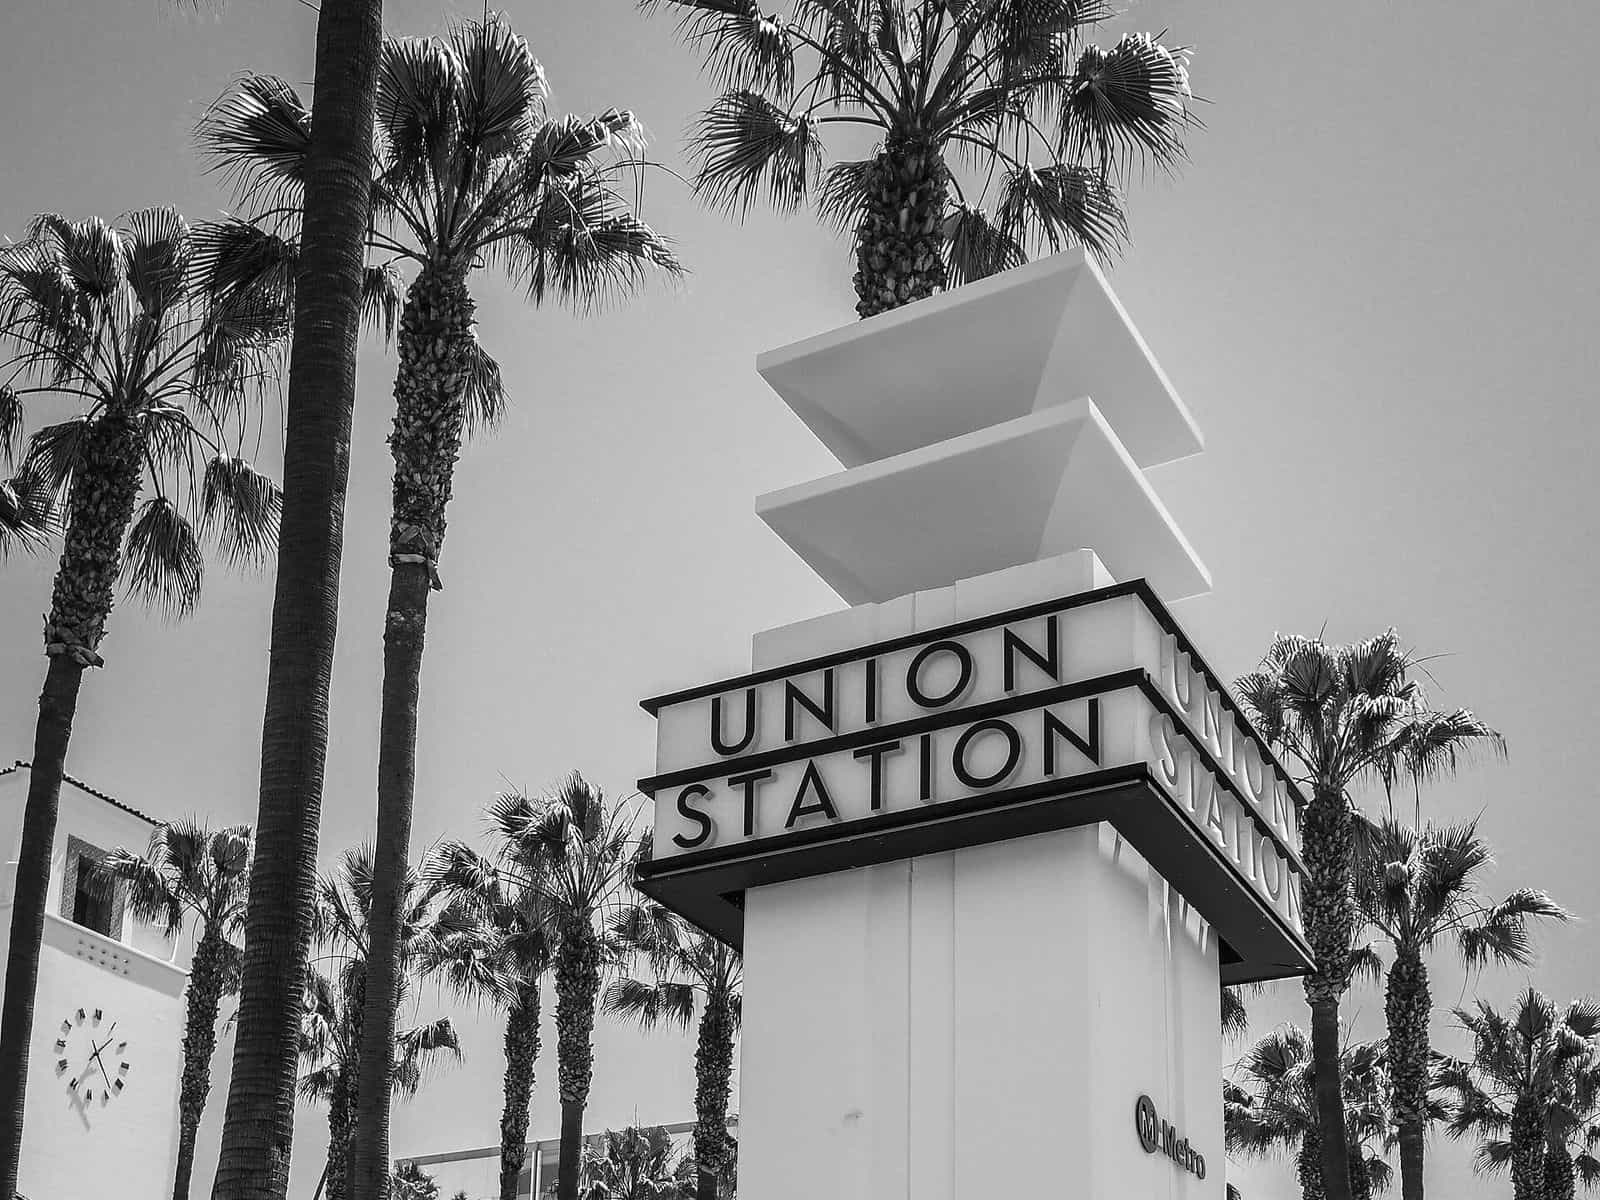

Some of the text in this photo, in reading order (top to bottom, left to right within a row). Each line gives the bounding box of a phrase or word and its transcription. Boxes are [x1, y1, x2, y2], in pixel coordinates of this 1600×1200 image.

[711, 615, 1057, 755] UNION
[1160, 634, 1301, 853] UNION
[672, 697, 1099, 848] STATION
[1150, 713, 1304, 935] STATION
[1162, 1119, 1205, 1179] Metro
